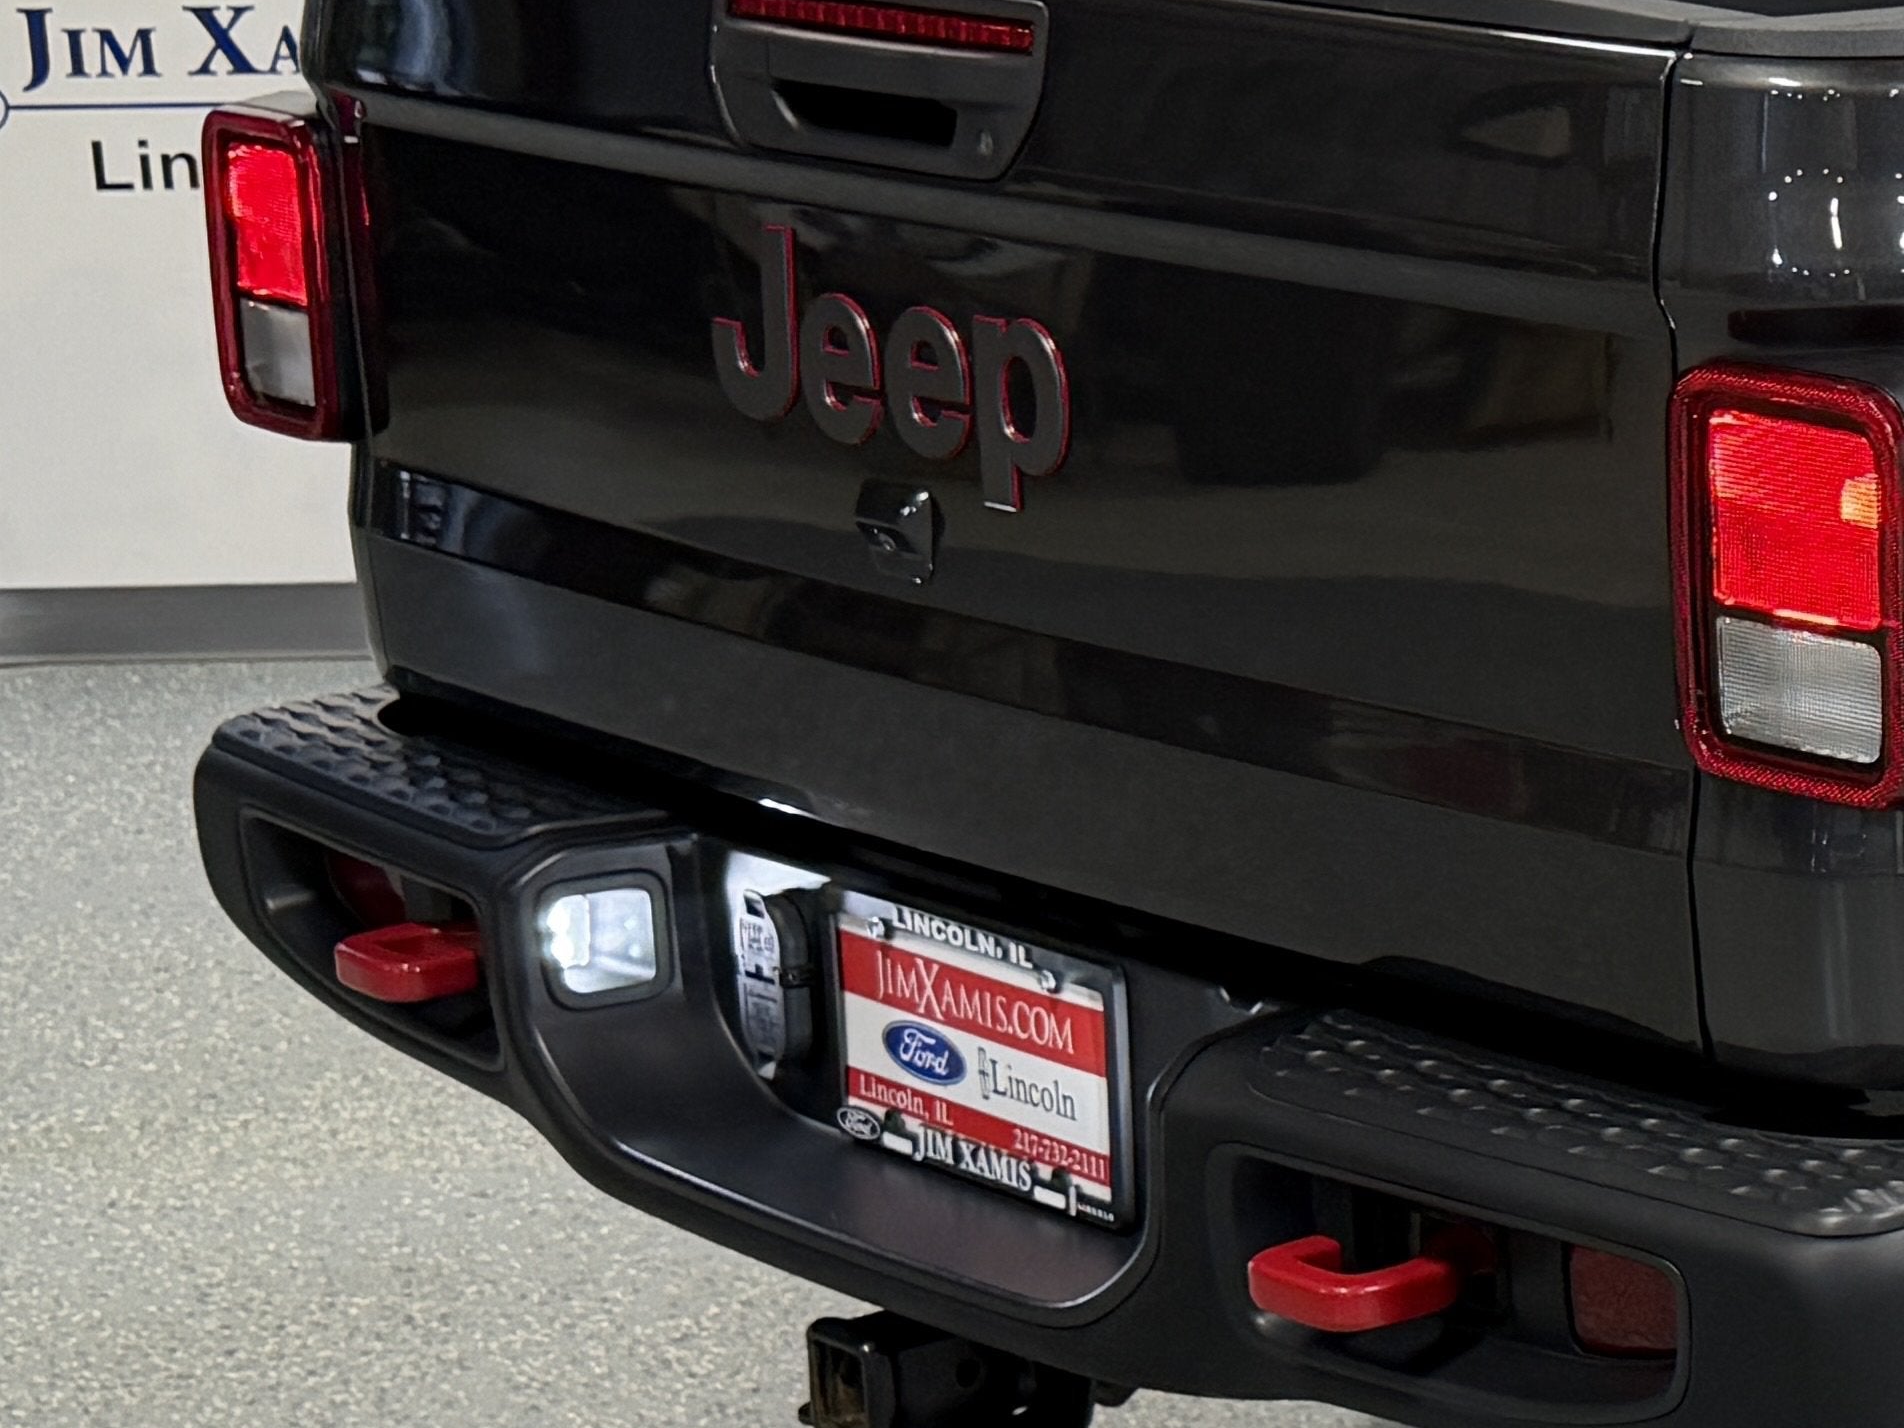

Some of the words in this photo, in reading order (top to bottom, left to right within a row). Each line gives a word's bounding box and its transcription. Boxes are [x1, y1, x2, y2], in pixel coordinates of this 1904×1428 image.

[15, 6, 163, 93] JIM
[711, 224, 1072, 513] Jeep
[1009, 941, 1034, 969] IL
[898, 1027, 950, 1075] Ford
[859, 1073, 930, 1119] Lincoln,
[935, 1098, 954, 1127] IL
[989, 1058, 1077, 1122] Lincoln
[912, 1126, 955, 1164] JIM
[960, 1137, 1032, 1192] XAMIS
[1011, 1127, 1107, 1181] 217-732-2111
